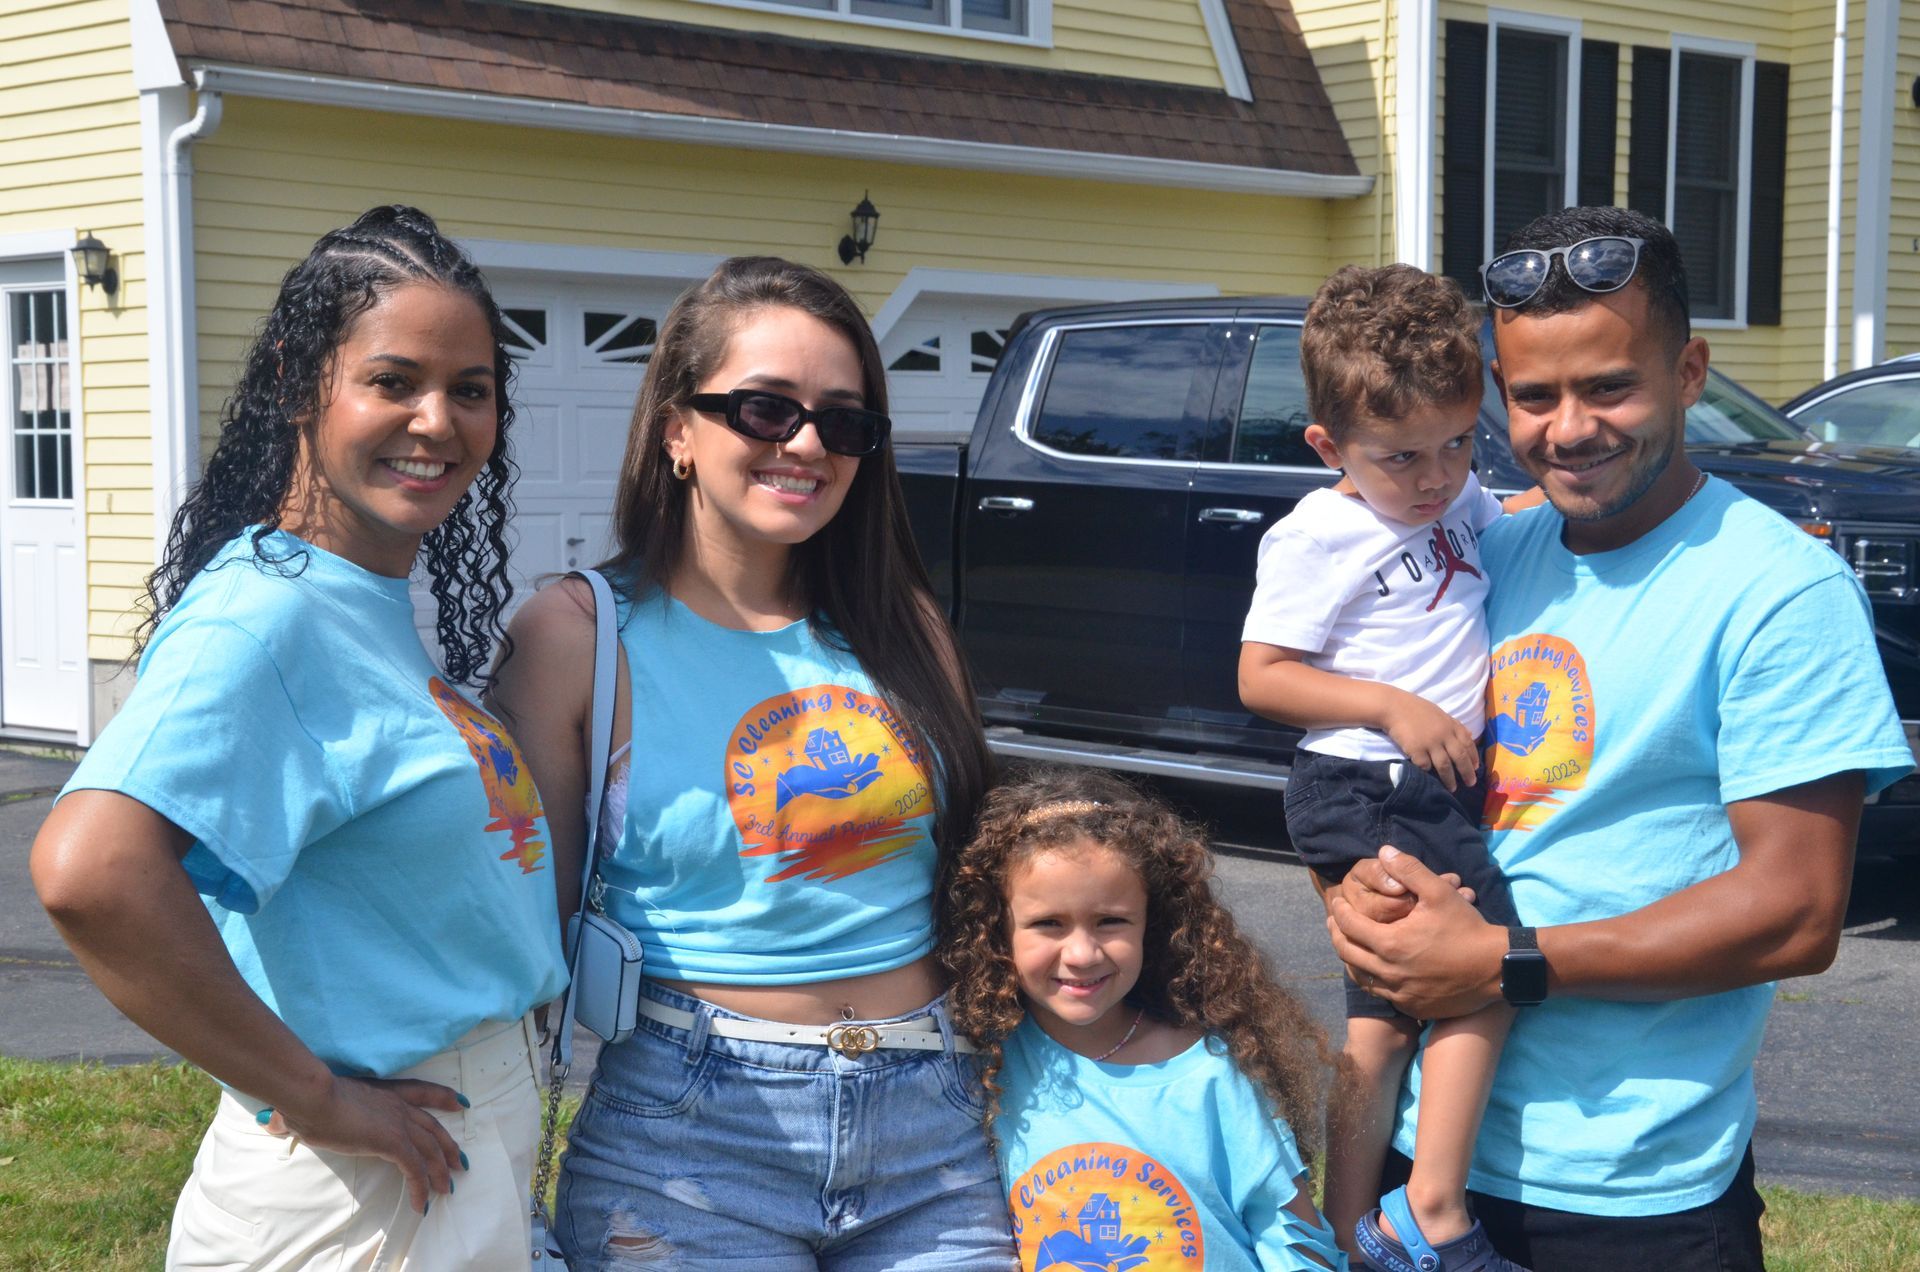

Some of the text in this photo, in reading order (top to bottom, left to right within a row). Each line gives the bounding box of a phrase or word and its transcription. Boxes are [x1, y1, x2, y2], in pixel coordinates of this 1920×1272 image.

[1374, 520, 1478, 597] JORDA
[738, 692, 833, 755] Cleaning
[1542, 759, 1582, 784] 2023
[744, 813, 775, 837] 3rd
[776, 823, 836, 843] Annual
[841, 814, 886, 836] Picnic
[894, 782, 929, 816] 2023
[1019, 1149, 1128, 1209] Cleaning
[1136, 1161, 1198, 1259] Services
